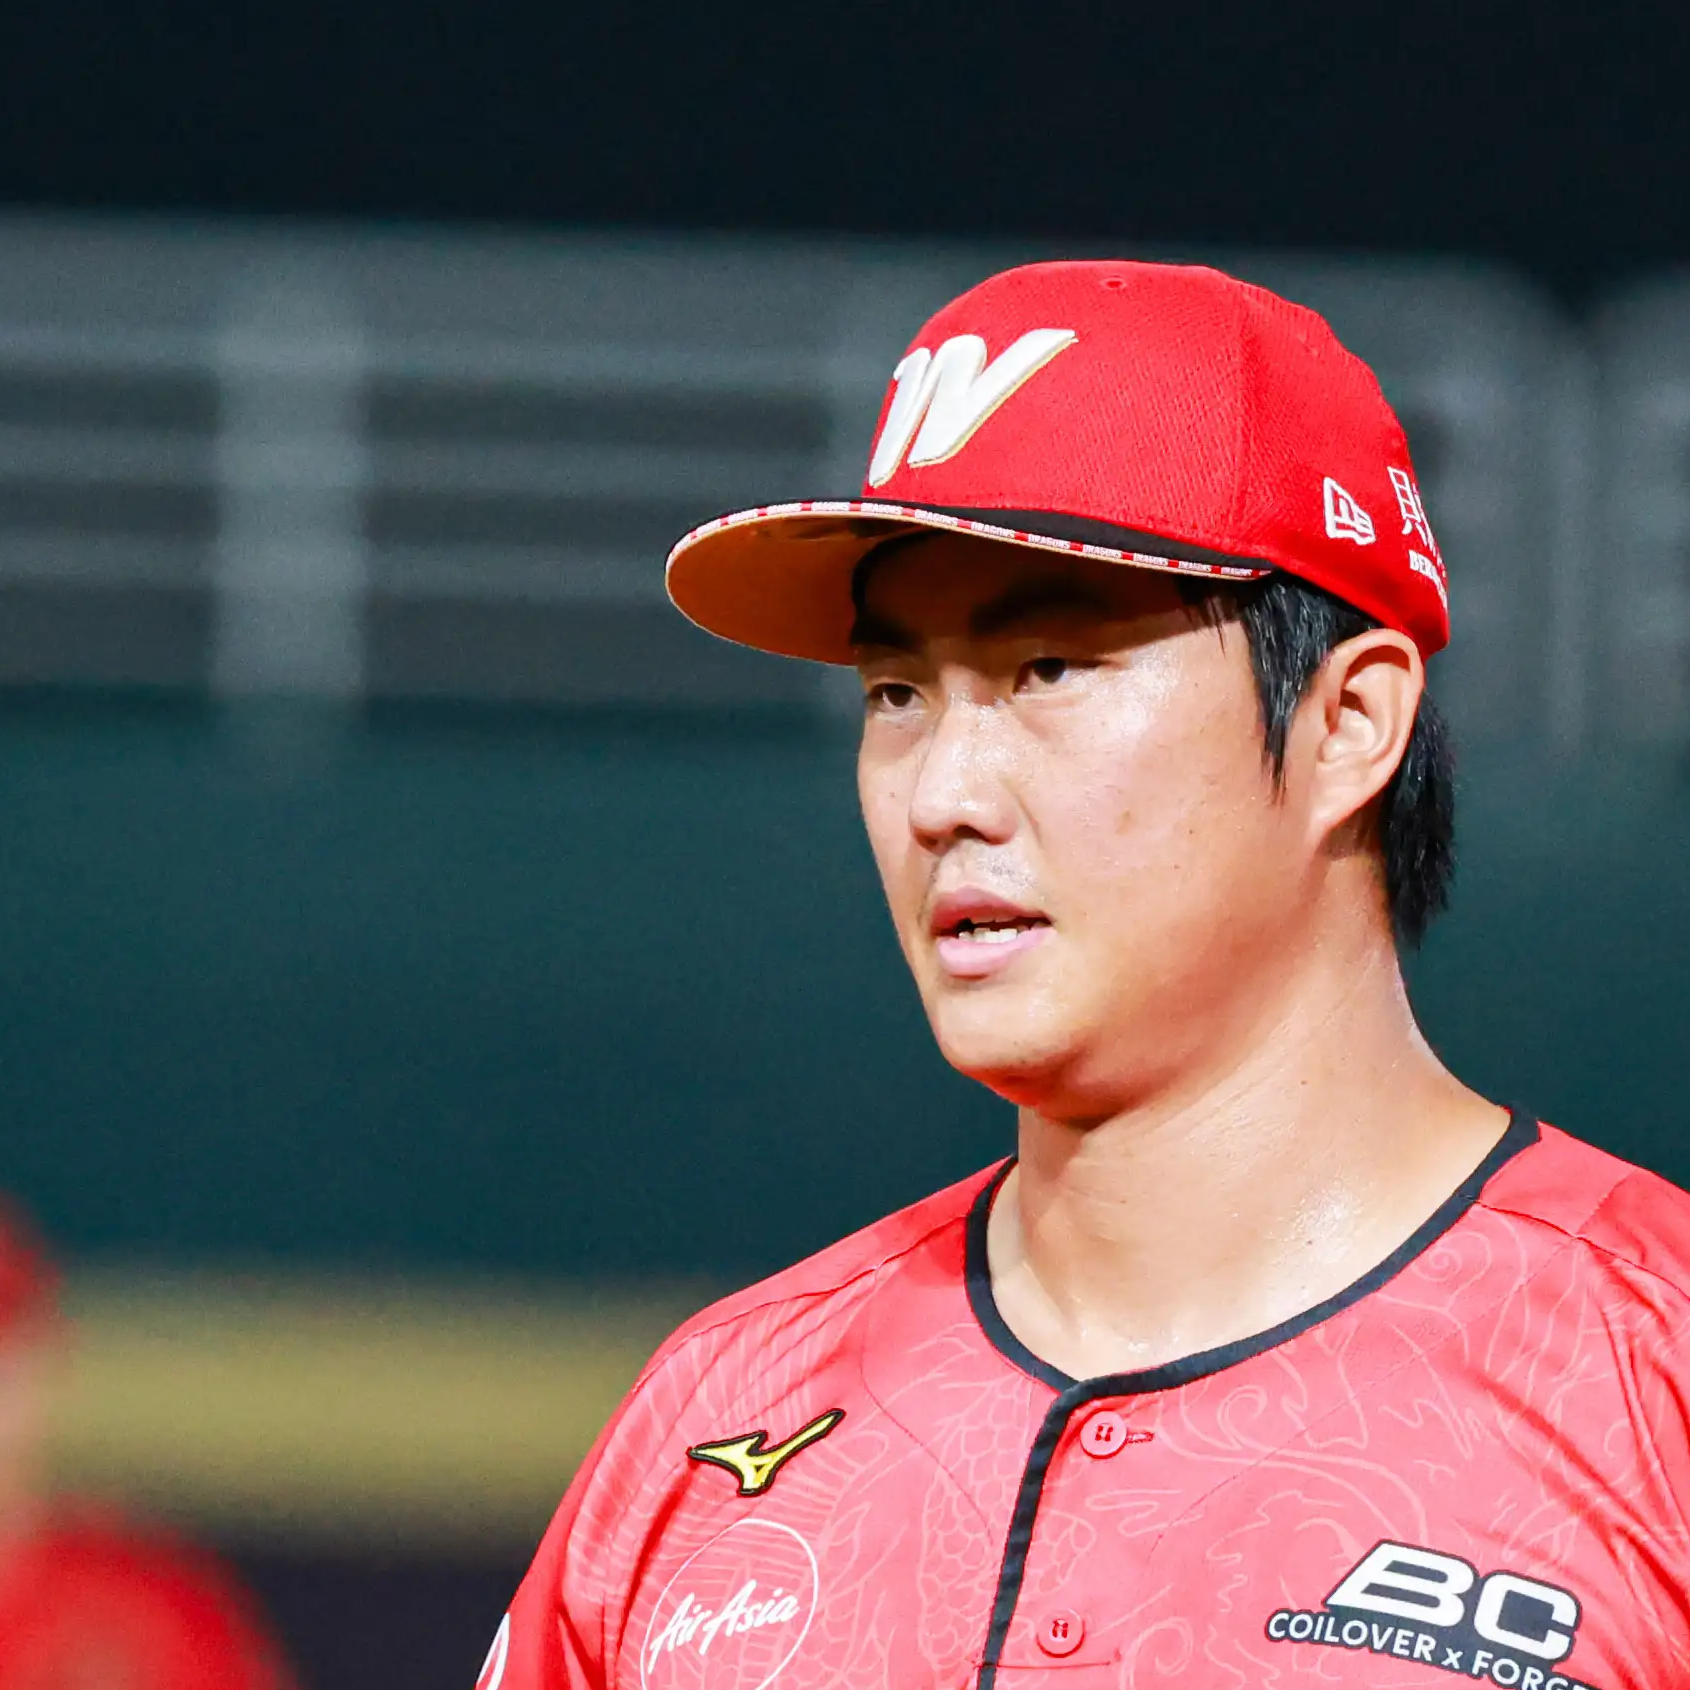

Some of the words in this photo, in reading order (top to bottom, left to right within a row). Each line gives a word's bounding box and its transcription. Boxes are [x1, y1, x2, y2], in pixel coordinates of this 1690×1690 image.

[648, 1579, 801, 1674] AirAsia
[1267, 1611, 1434, 1662] COILOVER
[1326, 1542, 1578, 1661] BC
